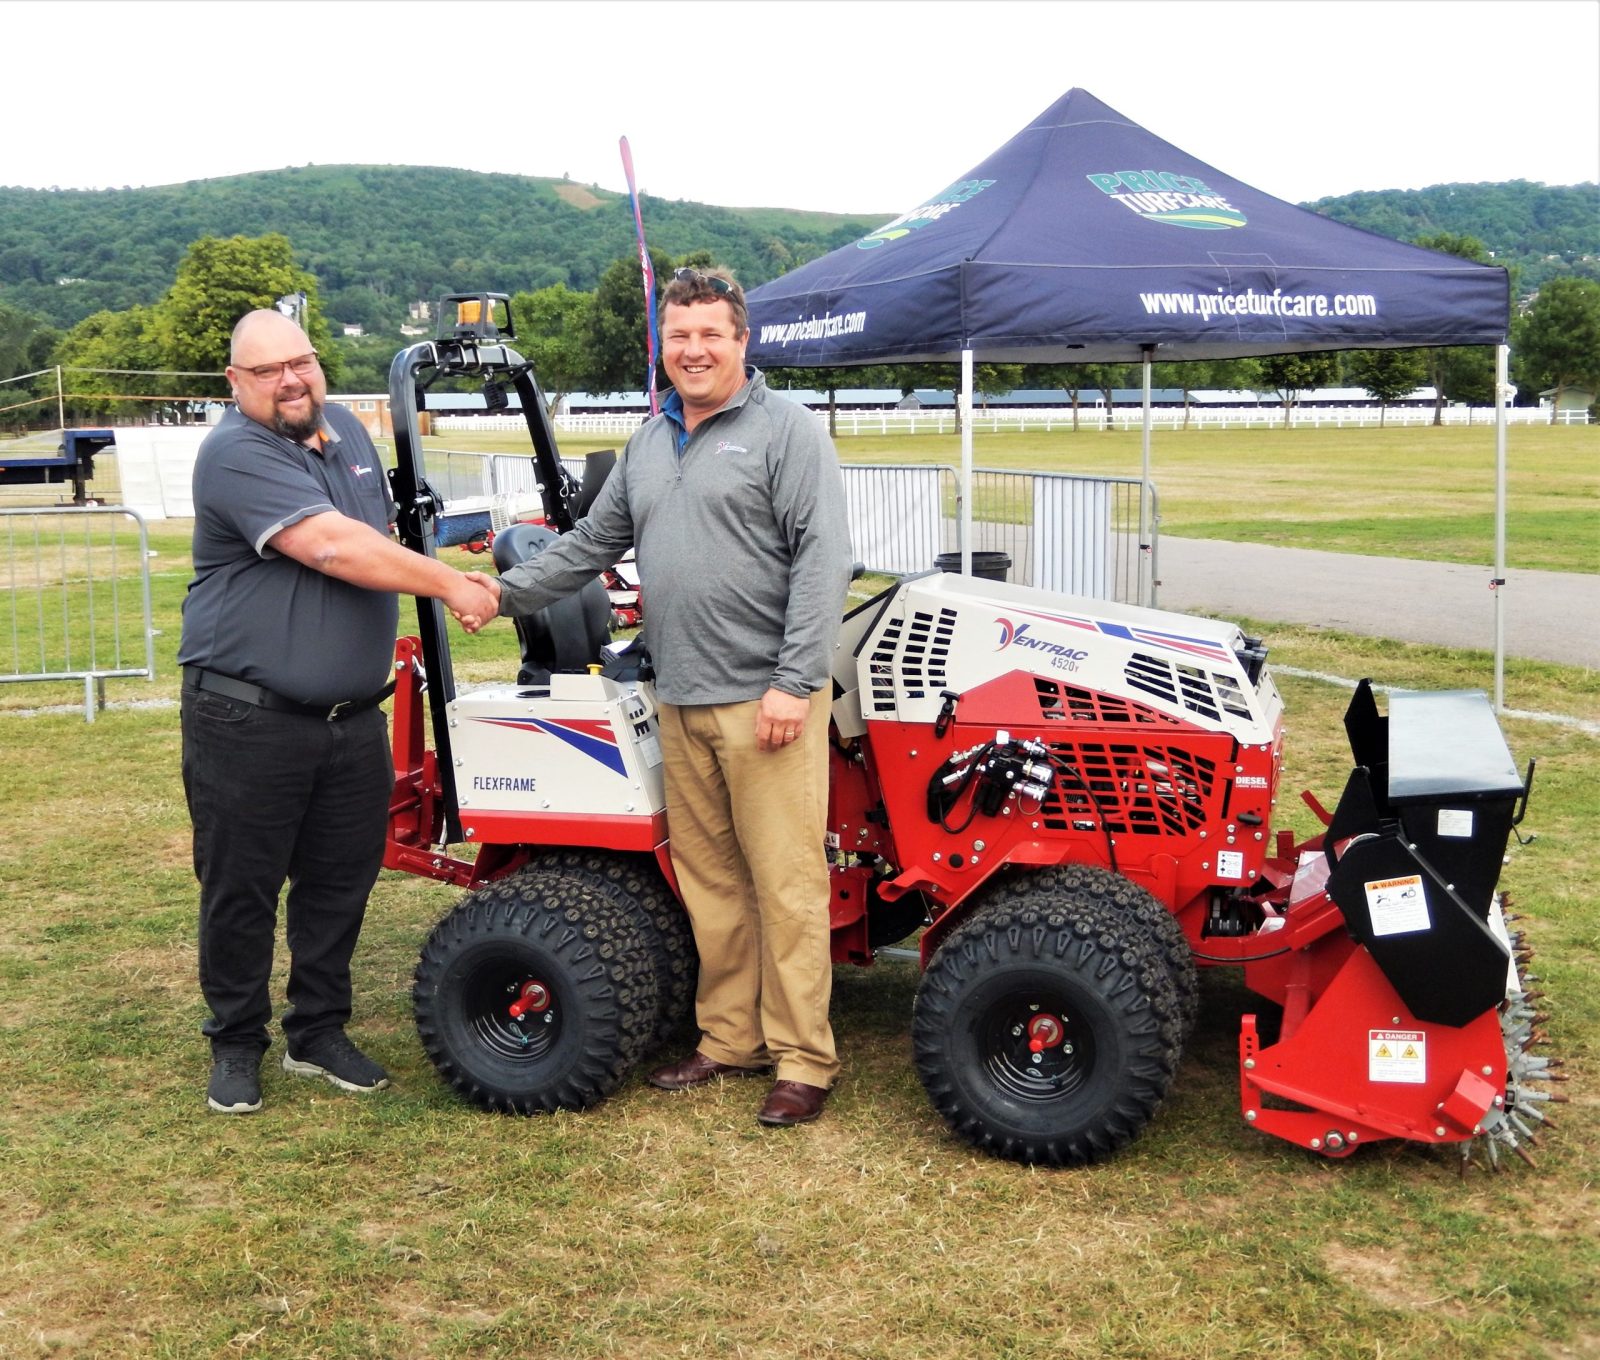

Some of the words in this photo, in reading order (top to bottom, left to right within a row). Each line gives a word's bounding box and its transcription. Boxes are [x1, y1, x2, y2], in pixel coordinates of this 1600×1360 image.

[1086, 169, 1220, 197] PRICE
[1109, 191, 1241, 214] TURFCARE
[1139, 287, 1378, 322] www.priceturfcare.com
[759, 311, 867, 348] www.priceturfcare.com
[992, 617, 1089, 661] VENTRAC
[473, 776, 536, 792] FLEXFRAME
[1235, 776, 1268, 785] DIESEL
[1380, 878, 1416, 888] WARNING
